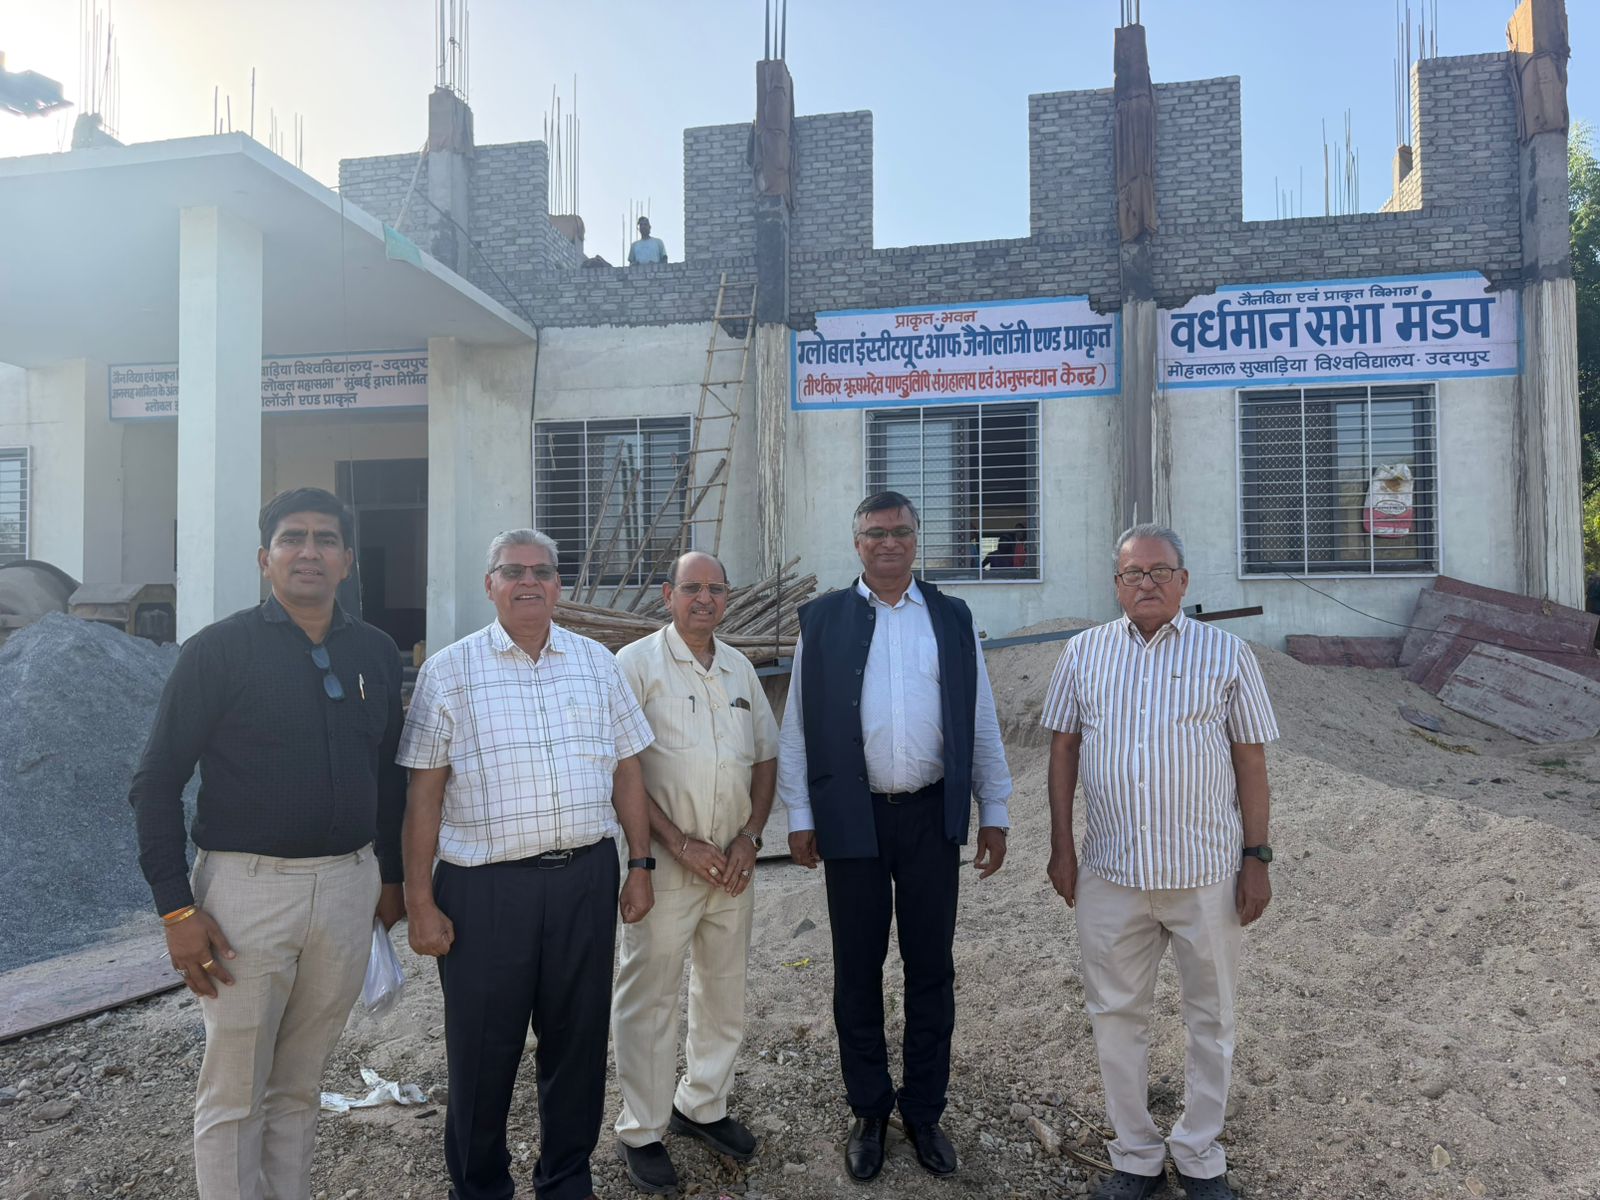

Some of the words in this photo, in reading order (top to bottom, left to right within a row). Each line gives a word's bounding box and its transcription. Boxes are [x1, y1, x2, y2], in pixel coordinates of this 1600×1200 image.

[1237, 290, 1292, 306] जैनविद्या
[1296, 288, 1320, 302] एवं
[1323, 288, 1364, 303] प्राकृत
[1369, 284, 1419, 298] विभाग
[1170, 299, 1301, 353] वर्धमान
[1304, 303, 1385, 347] सभा
[1392, 289, 1496, 342] मंडप
[798, 331, 855, 365] ग्लोबल
[925, 323, 961, 359] ऑफ
[960, 319, 1032, 357] जैनोलॉजी
[1033, 326, 1062, 353] एण्ड
[1063, 323, 1113, 359] प्राकृत
[1167, 361, 1236, 379] मोहनलाल
[1240, 355, 1308, 378] सुखाड़िया
[1314, 351, 1415, 371] विश्वविद्यालय
[1425, 350, 1490, 367] उदयपुर
[261, 377, 296, 391] लोबल
[843, 372, 884, 398] ऋषभदेव
[931, 368, 977, 393] संग्रहालय
[978, 366, 994, 390] एवं
[995, 368, 1058, 392] अनुसन्धान
